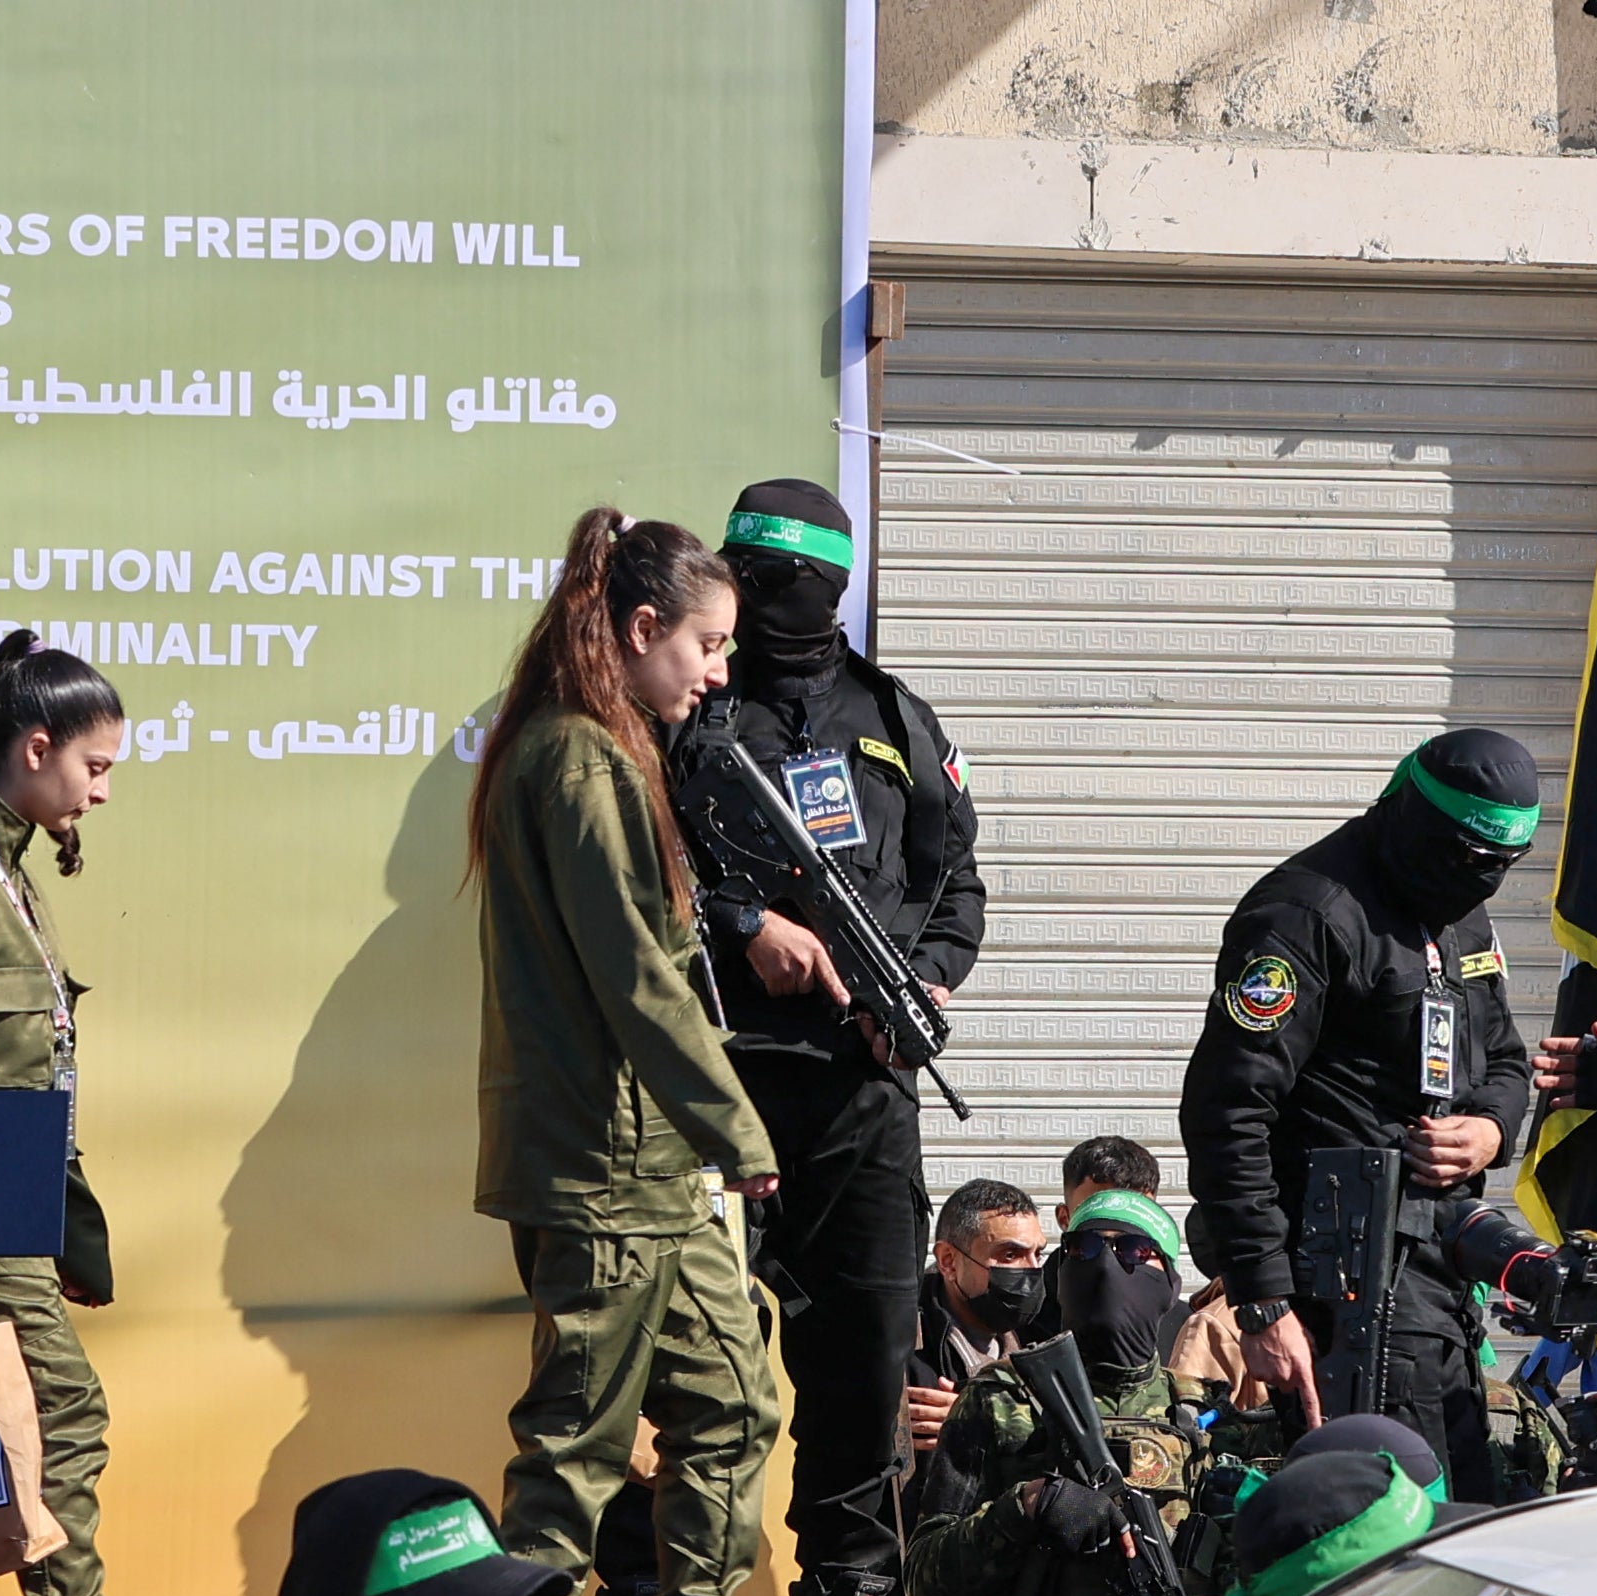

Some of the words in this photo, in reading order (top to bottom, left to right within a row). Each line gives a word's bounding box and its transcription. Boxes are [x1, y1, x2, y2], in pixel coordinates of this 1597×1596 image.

[68, 213, 145, 257] OF
[163, 215, 435, 264] FREEDOM
[452, 222, 581, 268] WILL
[272, 369, 427, 430] الحرية
[446, 377, 617, 432] مقاتلو
[210, 551, 457, 598] AGAINST
[120, 700, 194, 762] ثور
[248, 704, 436, 760] الأقصى
[398, 1531, 471, 1574] القسام
